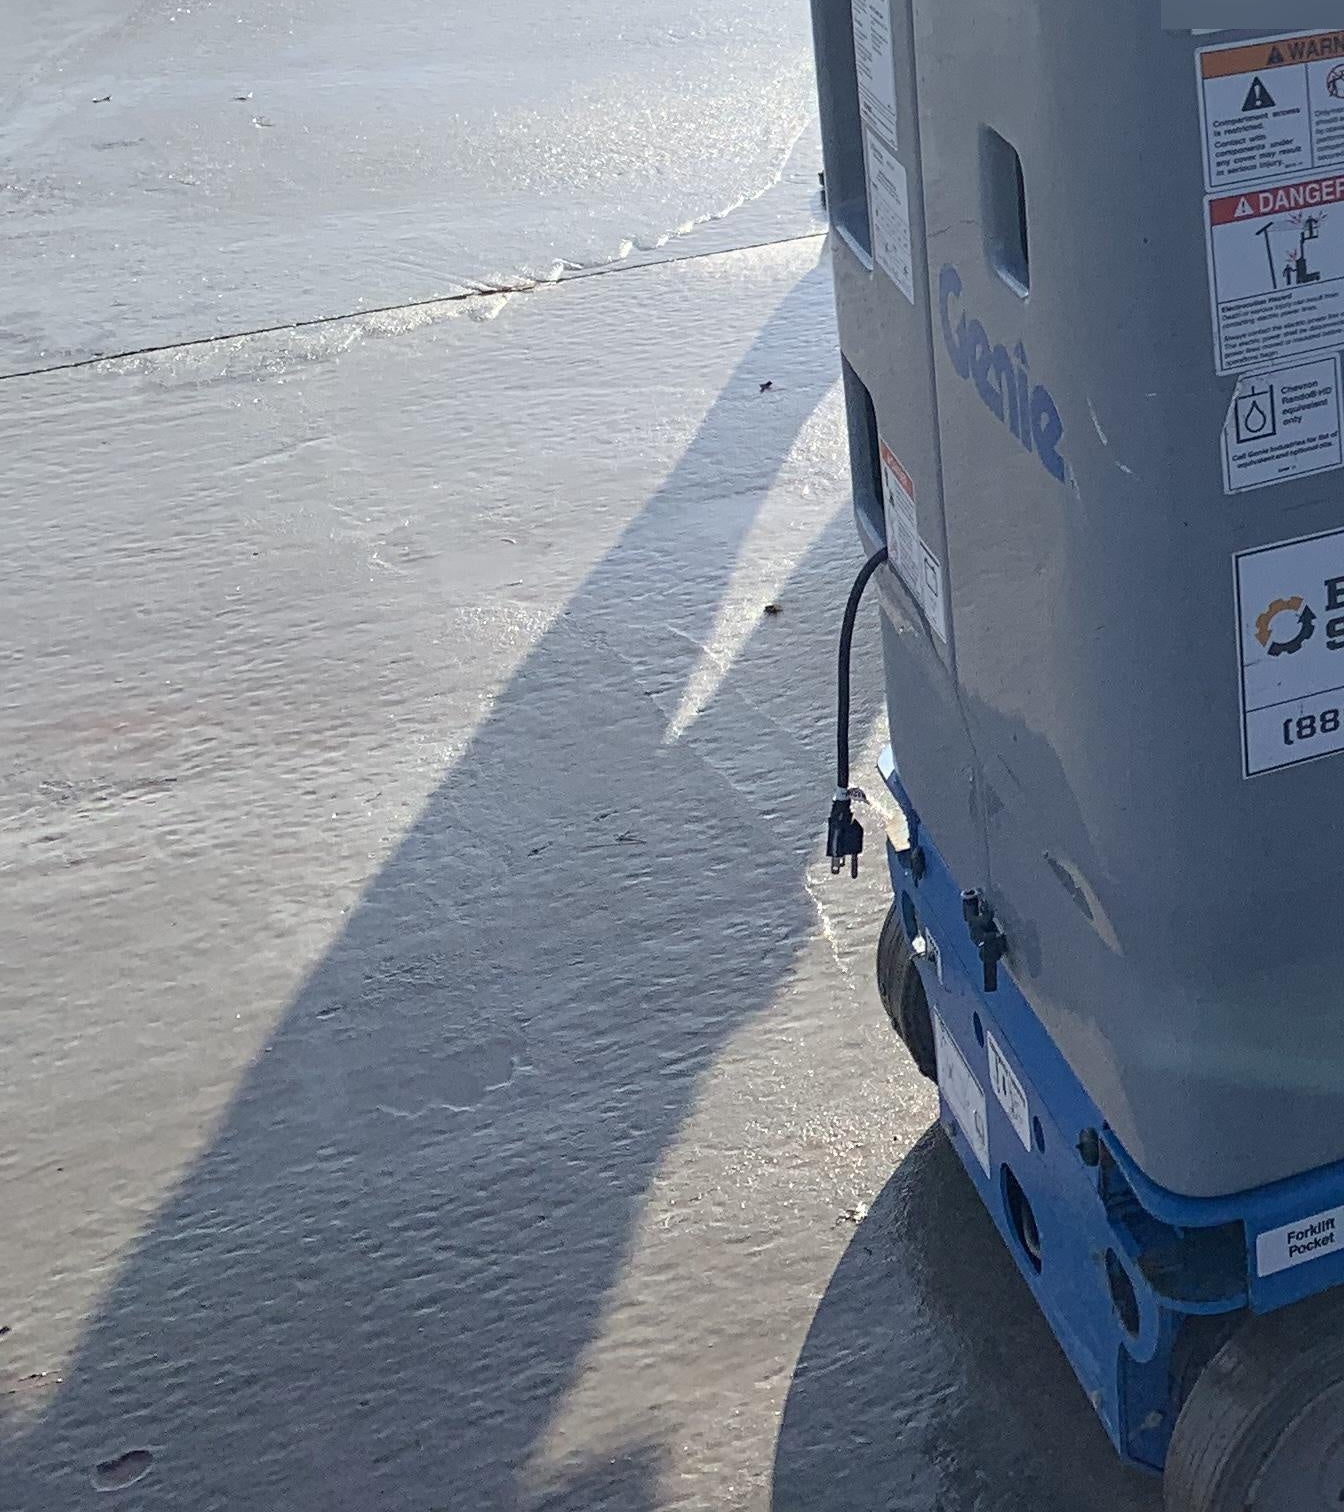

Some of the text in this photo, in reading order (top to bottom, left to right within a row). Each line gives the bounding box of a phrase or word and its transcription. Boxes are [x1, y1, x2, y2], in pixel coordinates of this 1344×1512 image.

[939, 262, 1065, 485] Genie
[1287, 1217, 1335, 1244] Forklift
[1289, 1232, 1335, 1257] Pocket
